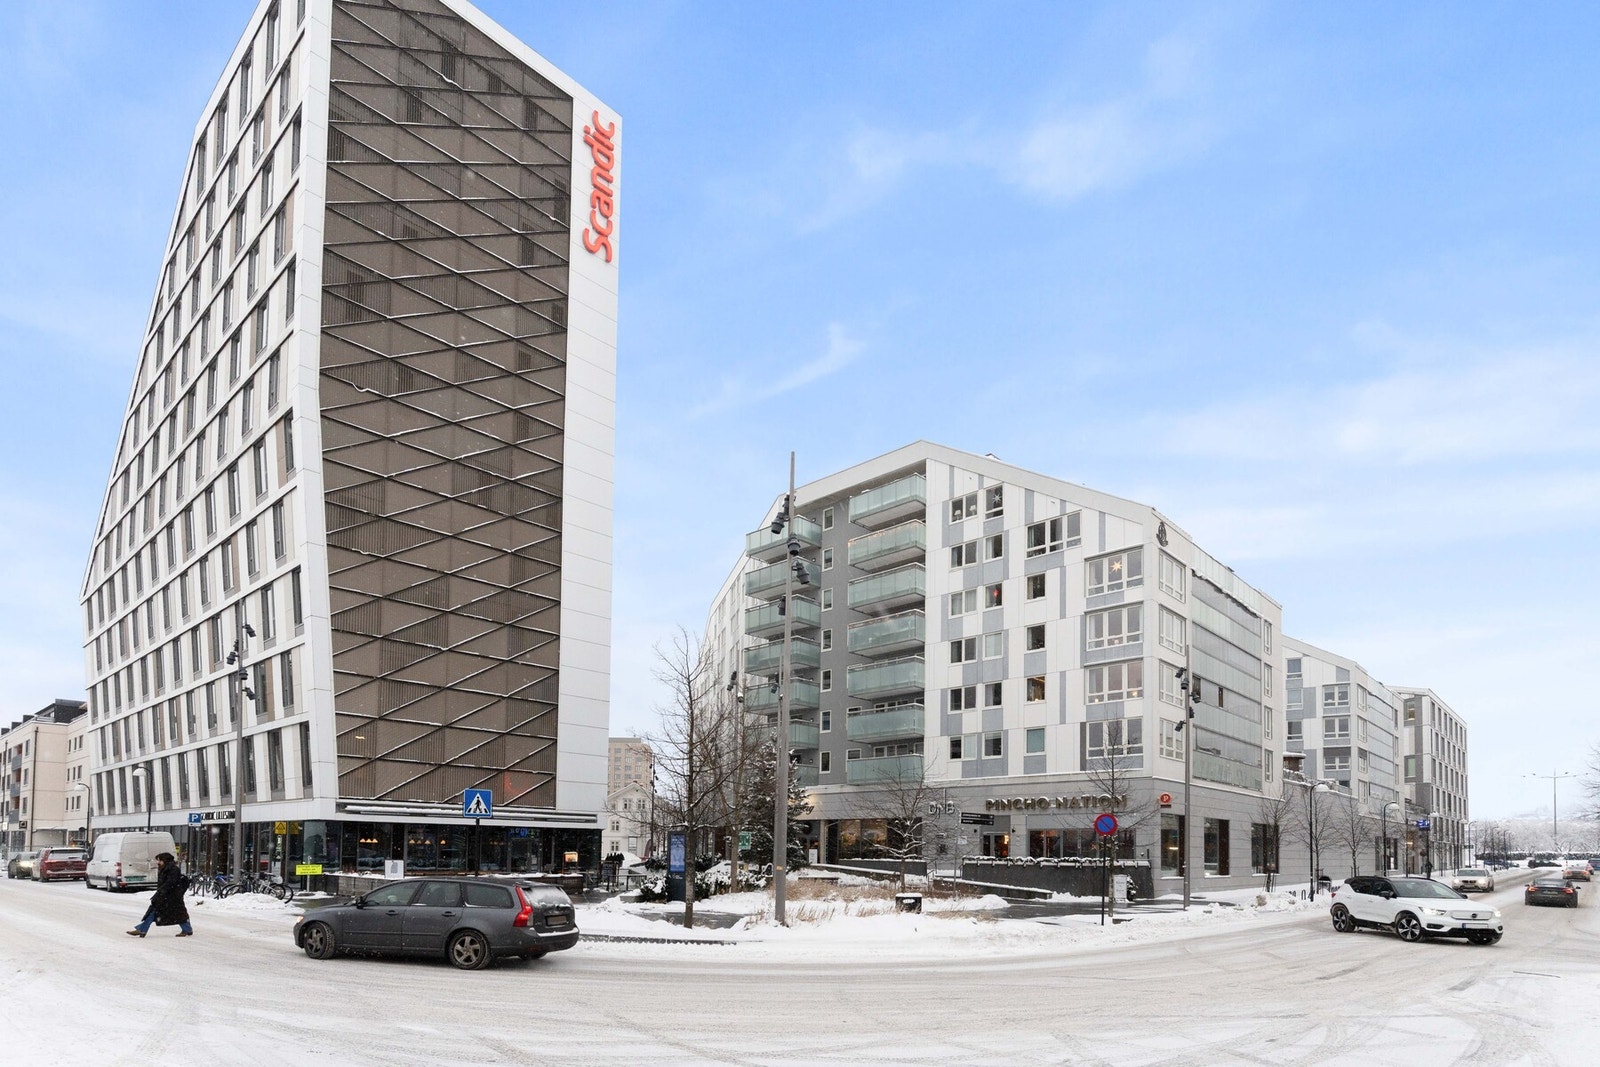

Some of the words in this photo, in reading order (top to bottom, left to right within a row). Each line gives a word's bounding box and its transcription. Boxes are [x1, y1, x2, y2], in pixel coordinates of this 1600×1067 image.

[583, 110, 615, 263] Scandic
[985, 796, 1049, 811] PINCHO
[1056, 794, 1127, 809] NATION
[192, 814, 199, 822] P
